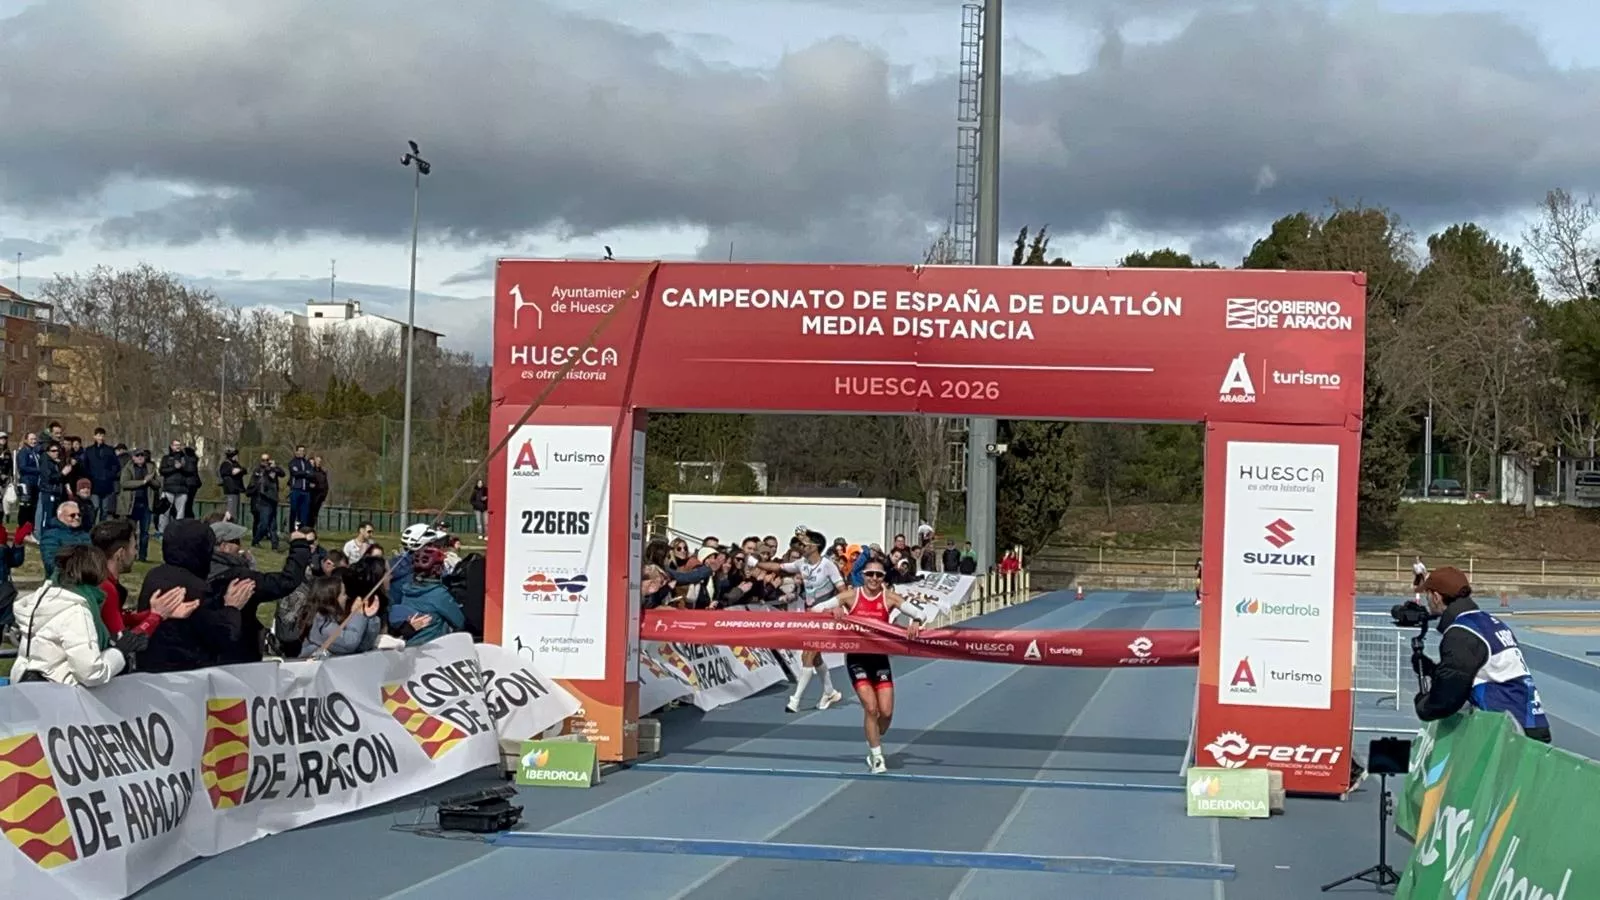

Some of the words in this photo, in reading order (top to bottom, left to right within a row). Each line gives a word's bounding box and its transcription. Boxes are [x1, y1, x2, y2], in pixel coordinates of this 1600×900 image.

[551, 286, 640, 300] Ayuntamieno
[551, 301, 566, 313] de
[661, 287, 845, 309] CAMPEONATO
[853, 290, 887, 310] DE
[896, 288, 1000, 313] ESPAÑA
[1009, 294, 1044, 314] DE
[1052, 291, 1182, 316] DUATLÓN
[1257, 299, 1341, 315] GOBIERNO
[802, 315, 884, 336] MEDIA
[893, 316, 1035, 340] DISTANCIA
[1257, 315, 1278, 329] DE
[1282, 315, 1352, 330] ARAGON
[511, 345, 618, 366] HUESCA
[521, 369, 533, 380] es
[562, 368, 607, 380] istoria
[1272, 370, 1341, 385] turismo
[834, 376, 934, 397] HUESCA
[940, 379, 1000, 400] 2026
[553, 451, 606, 464] turismo
[1240, 465, 1325, 482] HUESCA
[521, 510, 590, 535] 226ERS
[1243, 552, 1316, 566] SUZUKI
[1261, 602, 1320, 617] Iberdrola
[714, 620, 773, 629] CAMPEONATO
[774, 621, 786, 629] DE
[822, 622, 835, 630] DE
[965, 642, 1015, 652] HUESCA
[1270, 670, 1323, 682] turismo
[243, 753, 287, 805] DE
[525, 769, 589, 782] IBERDROLA
[1198, 799, 1266, 810] IBERDROLA
[66, 790, 122, 858] DE
